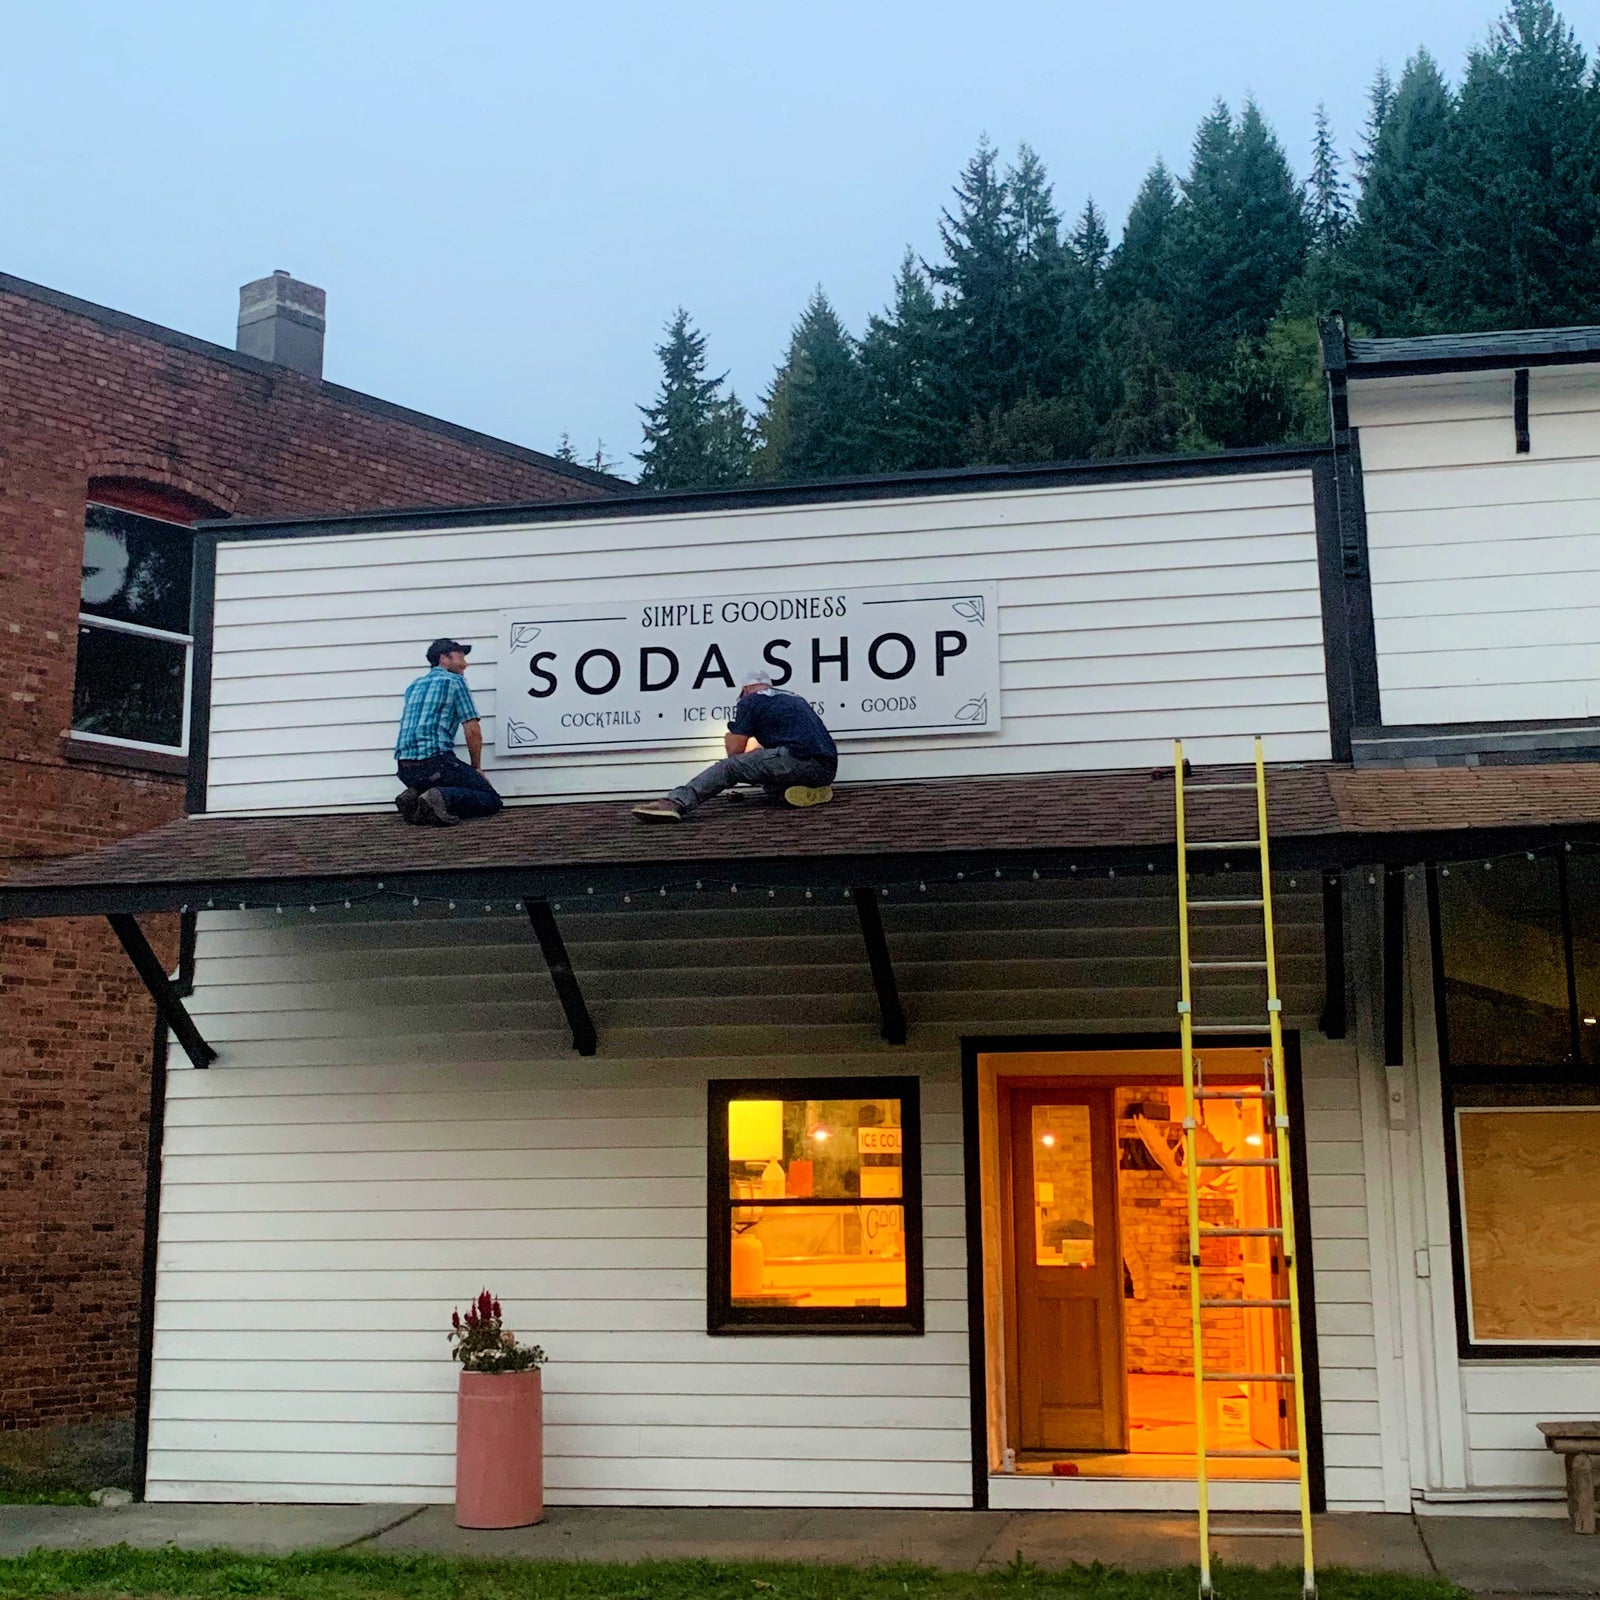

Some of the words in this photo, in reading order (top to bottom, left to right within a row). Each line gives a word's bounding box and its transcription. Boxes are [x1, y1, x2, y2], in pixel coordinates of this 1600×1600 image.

[641, 604, 714, 628] SIMPLE
[721, 596, 847, 623] GOODNESS
[528, 643, 736, 698] SODA
[763, 630, 968, 686] SHOP
[560, 710, 641, 728] COCKTAILS
[683, 706, 706, 721] ICE
[711, 705, 738, 721] CRE
[861, 696, 917, 713] GOODS
[861, 1133, 877, 1147] ICE
[880, 1133, 901, 1147] COL
